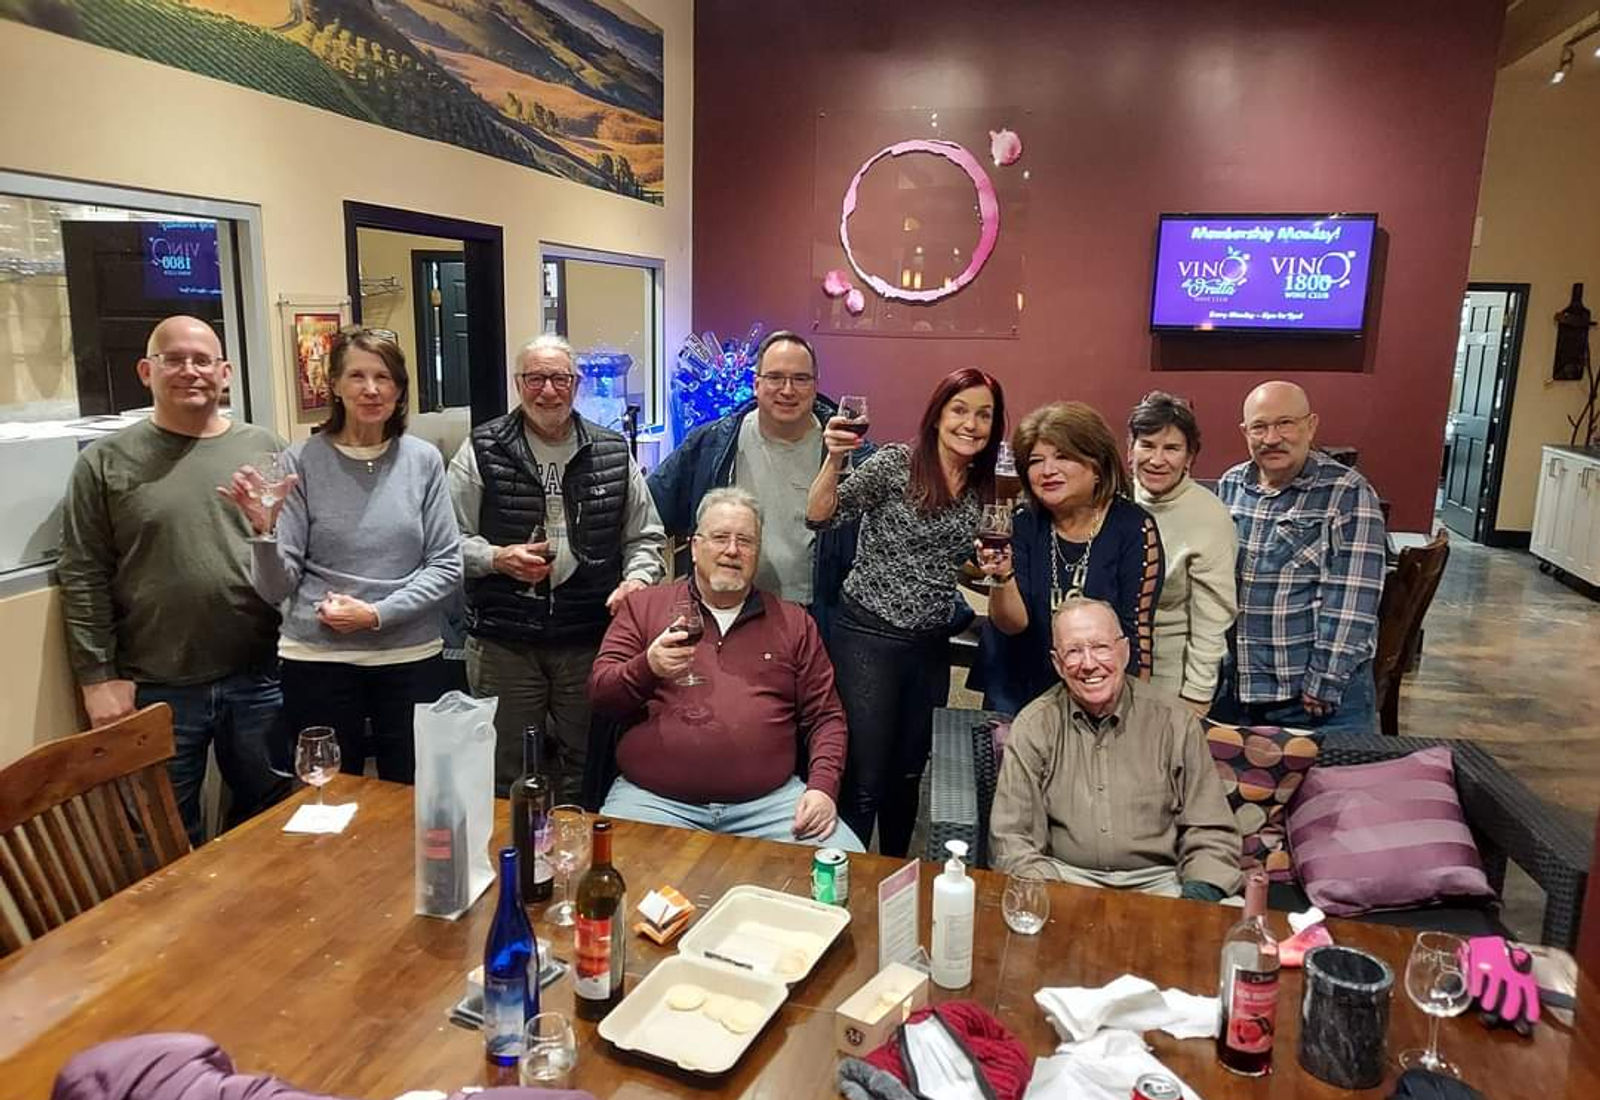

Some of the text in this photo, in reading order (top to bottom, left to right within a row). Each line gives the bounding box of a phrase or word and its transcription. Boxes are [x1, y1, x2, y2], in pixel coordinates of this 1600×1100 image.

[1190, 226, 1342, 244] Membership Monday!
[1178, 255, 1248, 284] VINO
[1271, 252, 1352, 284] VINO
[1285, 274, 1332, 292] 1800
